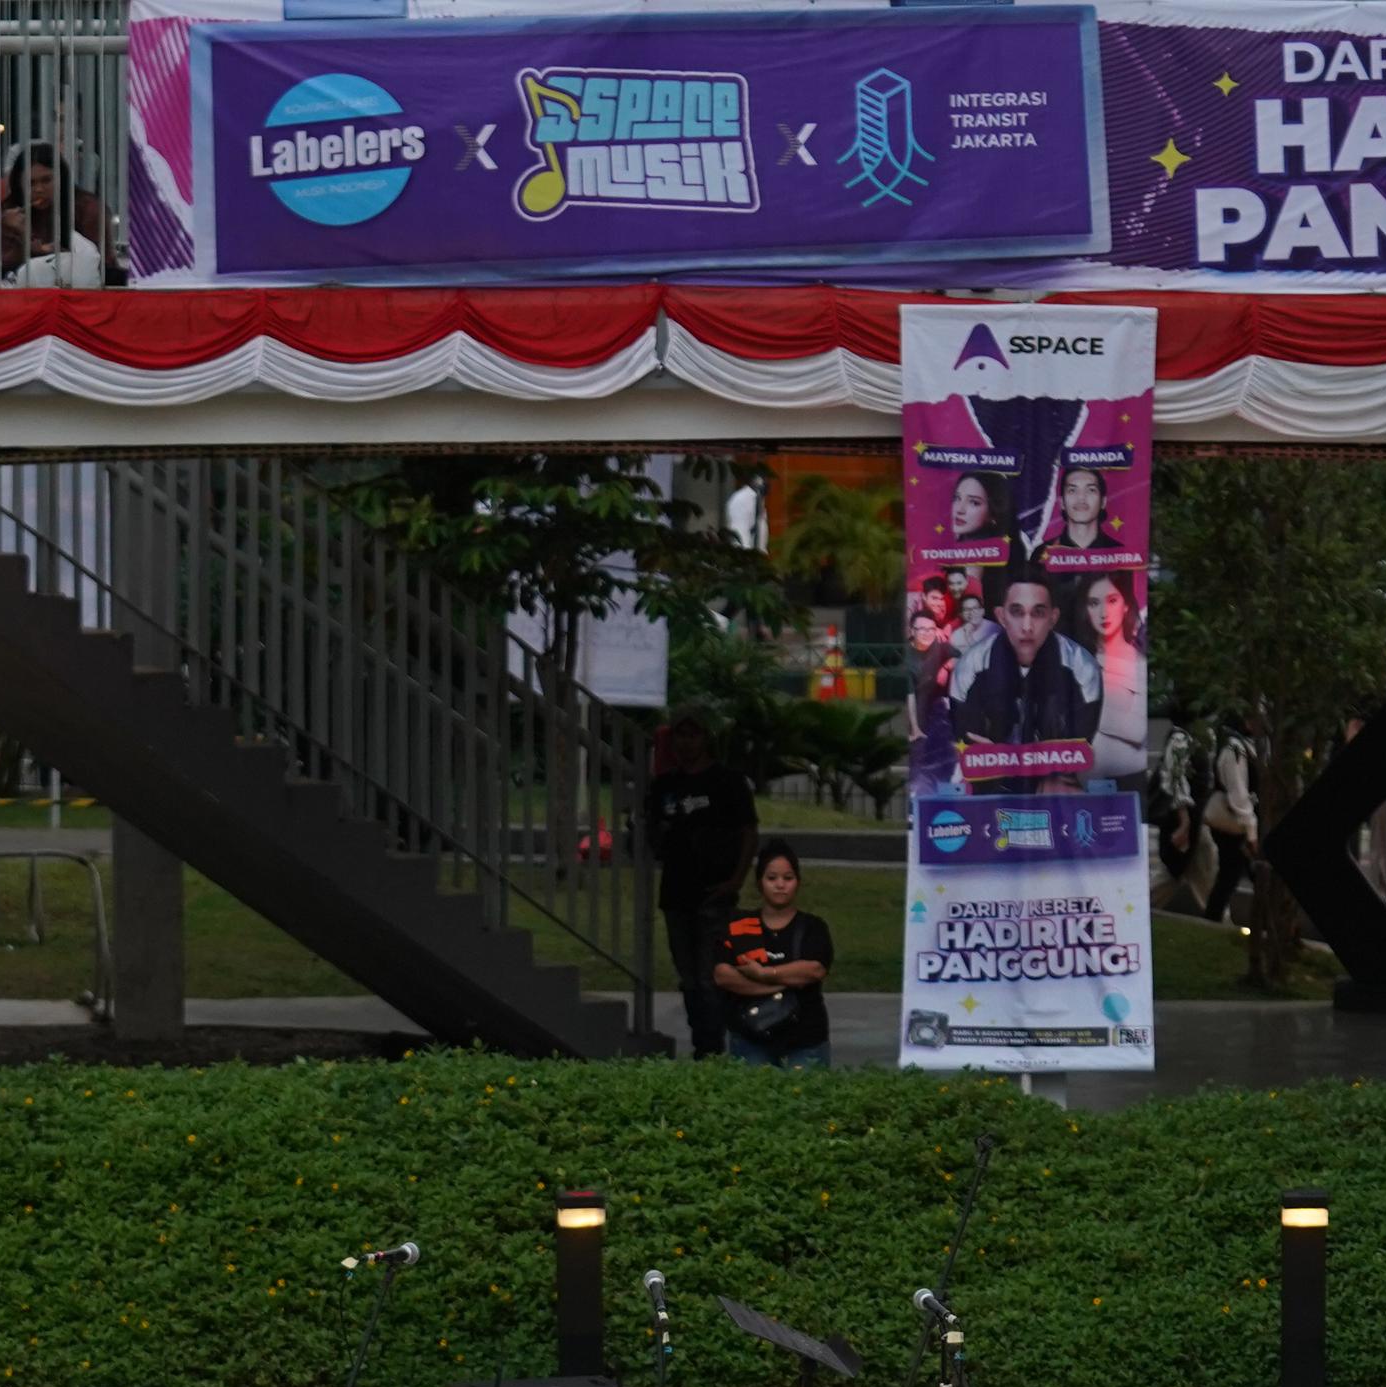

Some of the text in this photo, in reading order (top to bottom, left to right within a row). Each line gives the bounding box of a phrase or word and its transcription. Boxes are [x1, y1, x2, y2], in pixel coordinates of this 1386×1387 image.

[949, 92, 1047, 108] INTEGRASI
[950, 112, 1029, 128] TRANSIT
[951, 132, 1038, 149] JAKARTA
[250, 125, 425, 177] Labelers
[1009, 335, 1104, 356] SSPACE
[924, 451, 1016, 467] MAYSHA JUAN
[1069, 450, 1126, 464] DNANDA
[921, 549, 1000, 561] TONEWAVES
[1049, 552, 1143, 567] ALIKA SHAFIRA
[966, 749, 1086, 768] INDRA SINAGA
[949, 898, 1104, 918] DARI TV KERETA
[939, 917, 1116, 950] HADIR KE
[918, 945, 1141, 982] PANGGUNG!
